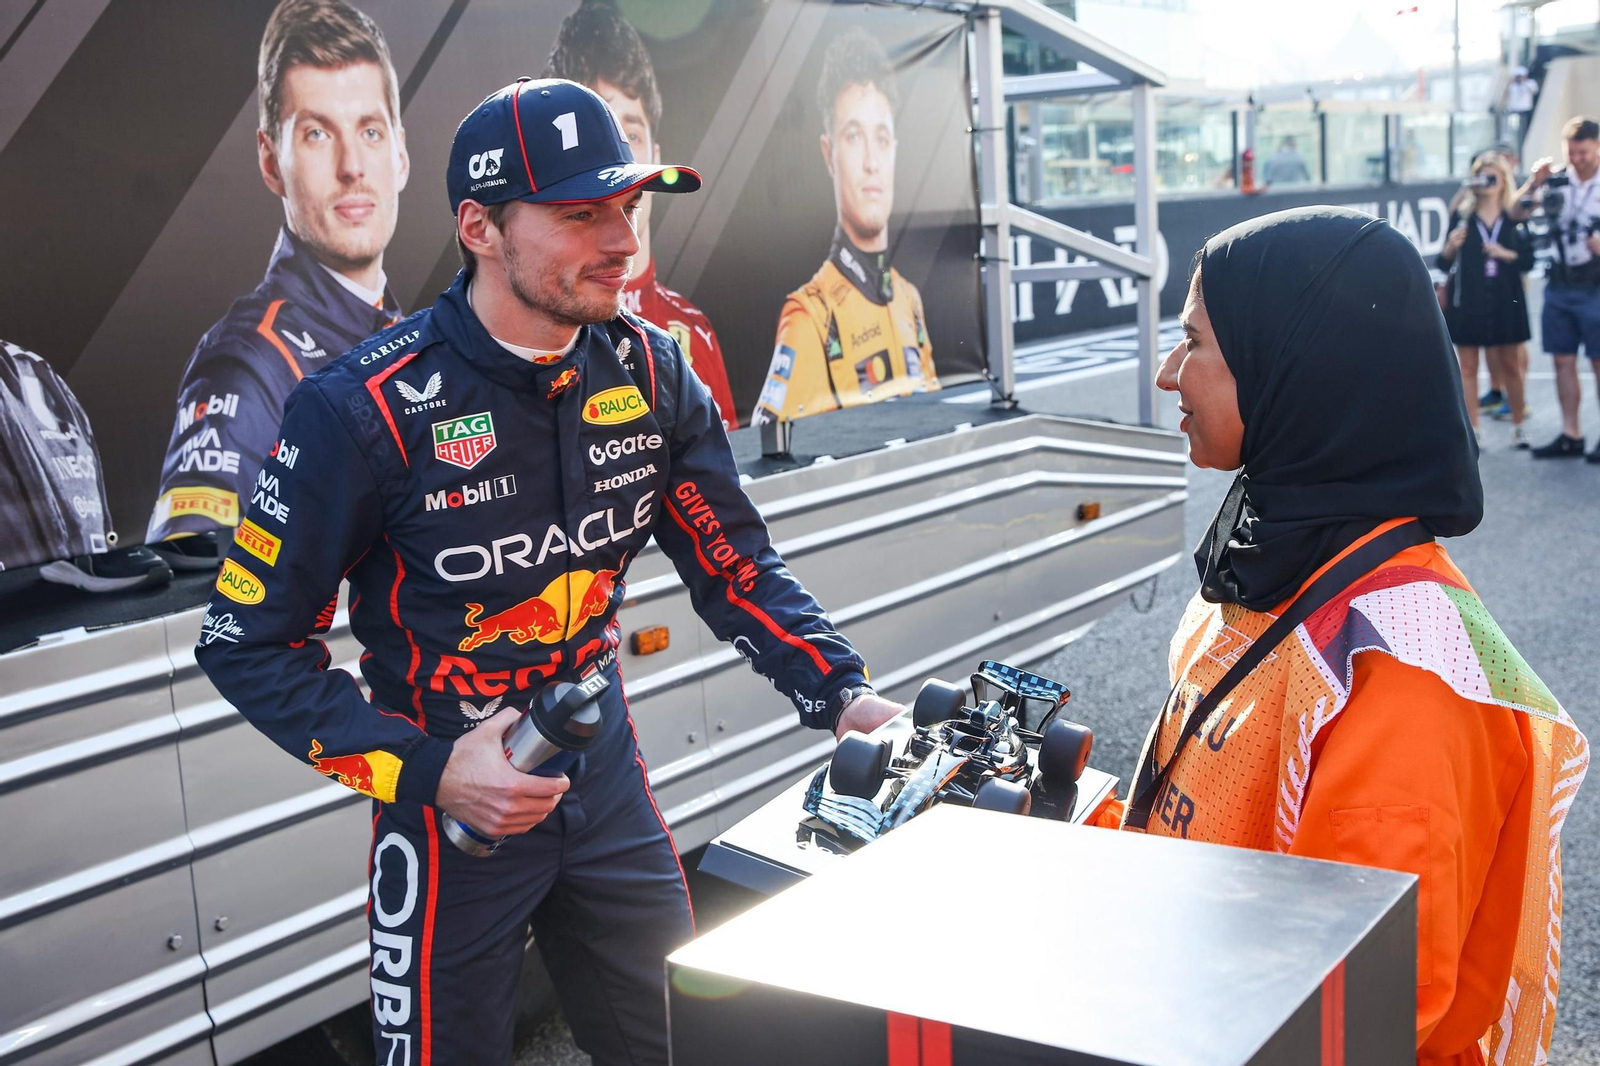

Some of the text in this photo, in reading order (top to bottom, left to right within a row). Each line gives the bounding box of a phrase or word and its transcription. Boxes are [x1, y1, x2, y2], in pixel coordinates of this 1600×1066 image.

[552, 111, 579, 151] 1
[178, 393, 239, 435] Mobil
[404, 399, 447, 415] CASTORE
[437, 416, 488, 440] TAG
[438, 436, 493, 467] HEUER
[594, 463, 658, 493] HONDA
[425, 480, 492, 512] Mobil
[675, 481, 721, 536] GIVES
[433, 490, 656, 582] ORACLE
[577, 674, 608, 696] YETI
